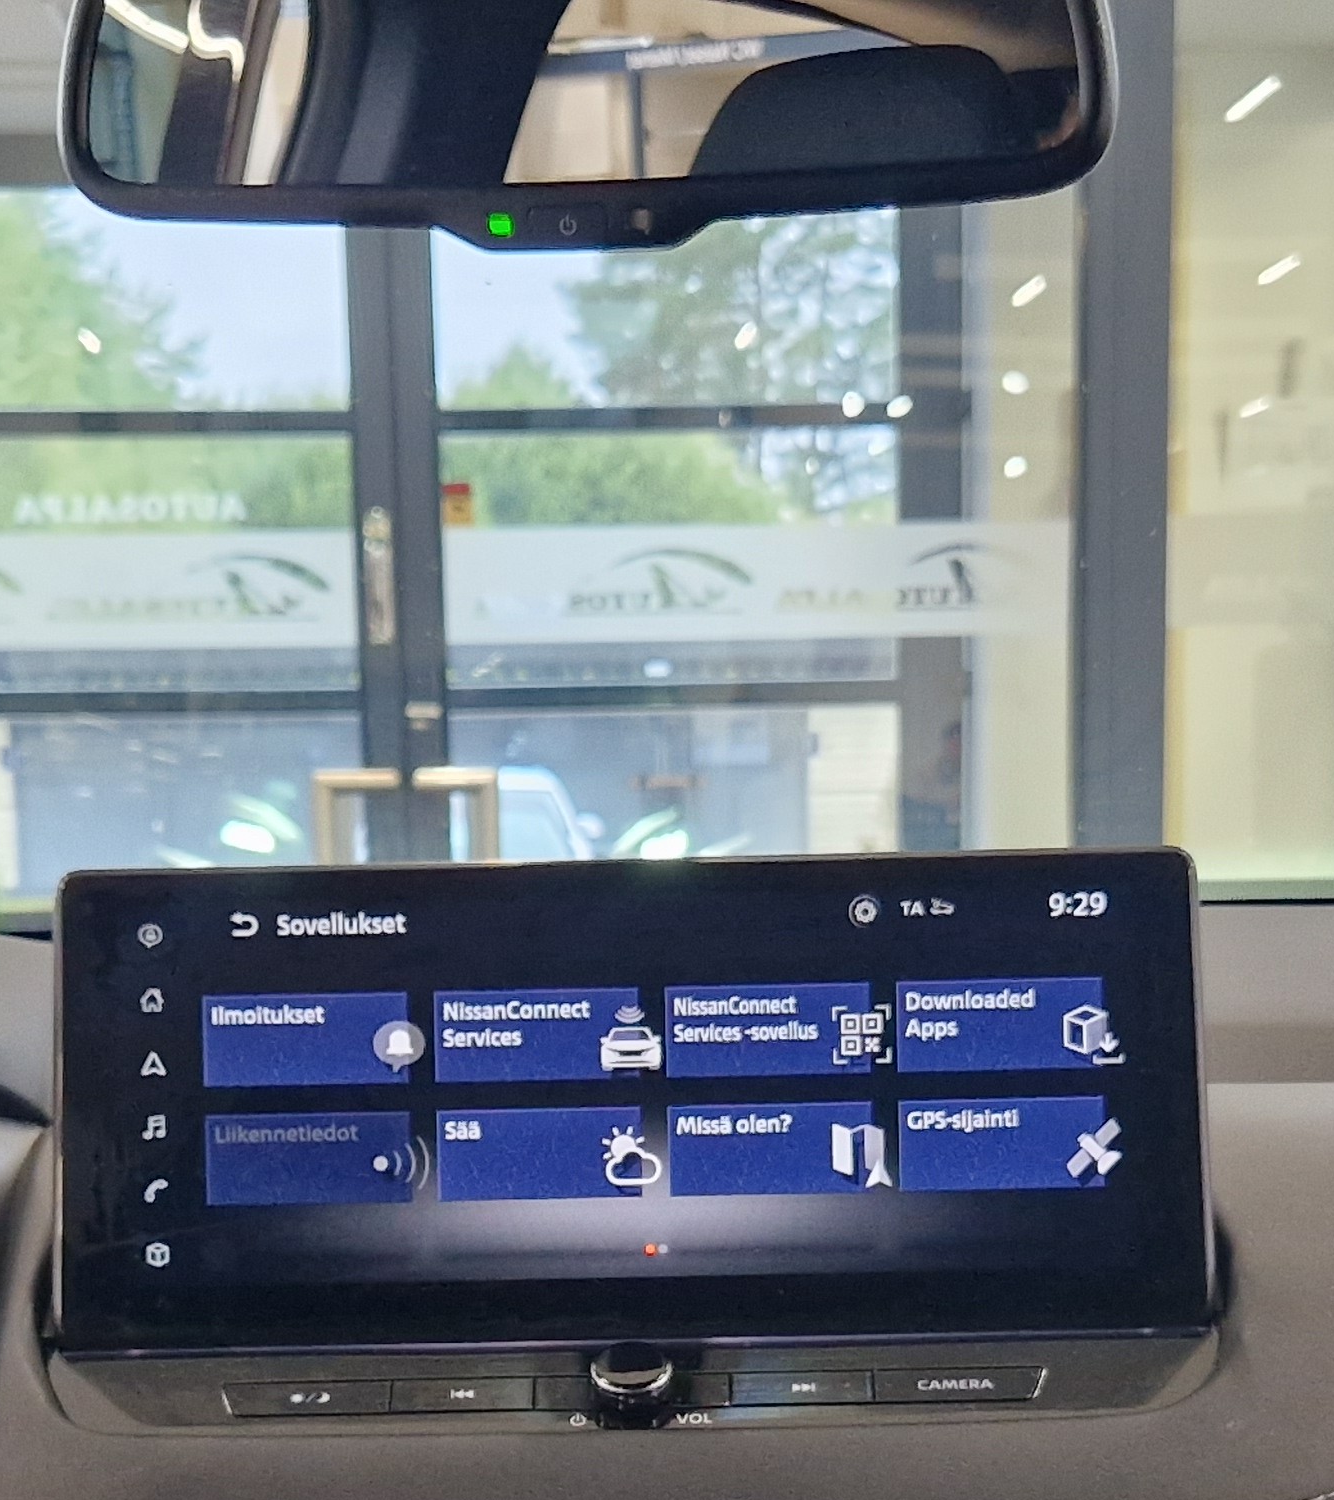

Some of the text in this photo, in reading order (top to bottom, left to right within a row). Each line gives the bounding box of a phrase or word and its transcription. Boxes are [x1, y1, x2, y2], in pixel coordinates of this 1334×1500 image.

[900, 900, 924, 916] TA
[1048, 892, 1108, 917] 9:29
[276, 911, 407, 937] Sovellukset
[673, 995, 798, 1016] NissanConnect
[905, 989, 1036, 1011] Downloaded
[211, 1004, 325, 1025] Ilmoitukset
[443, 1001, 590, 1021] NissanConnect
[442, 1029, 523, 1048] Services
[673, 1020, 819, 1043] Services -sovellus
[905, 1019, 958, 1041] Apps
[444, 1120, 481, 1141] Sää
[676, 1114, 792, 1135] Missä olen?
[906, 1108, 1019, 1132] GPS-sijainti
[215, 1124, 360, 1144] Liikennetiedot
[917, 1378, 995, 1391] CAMERA
[676, 1412, 712, 1425] VOL
